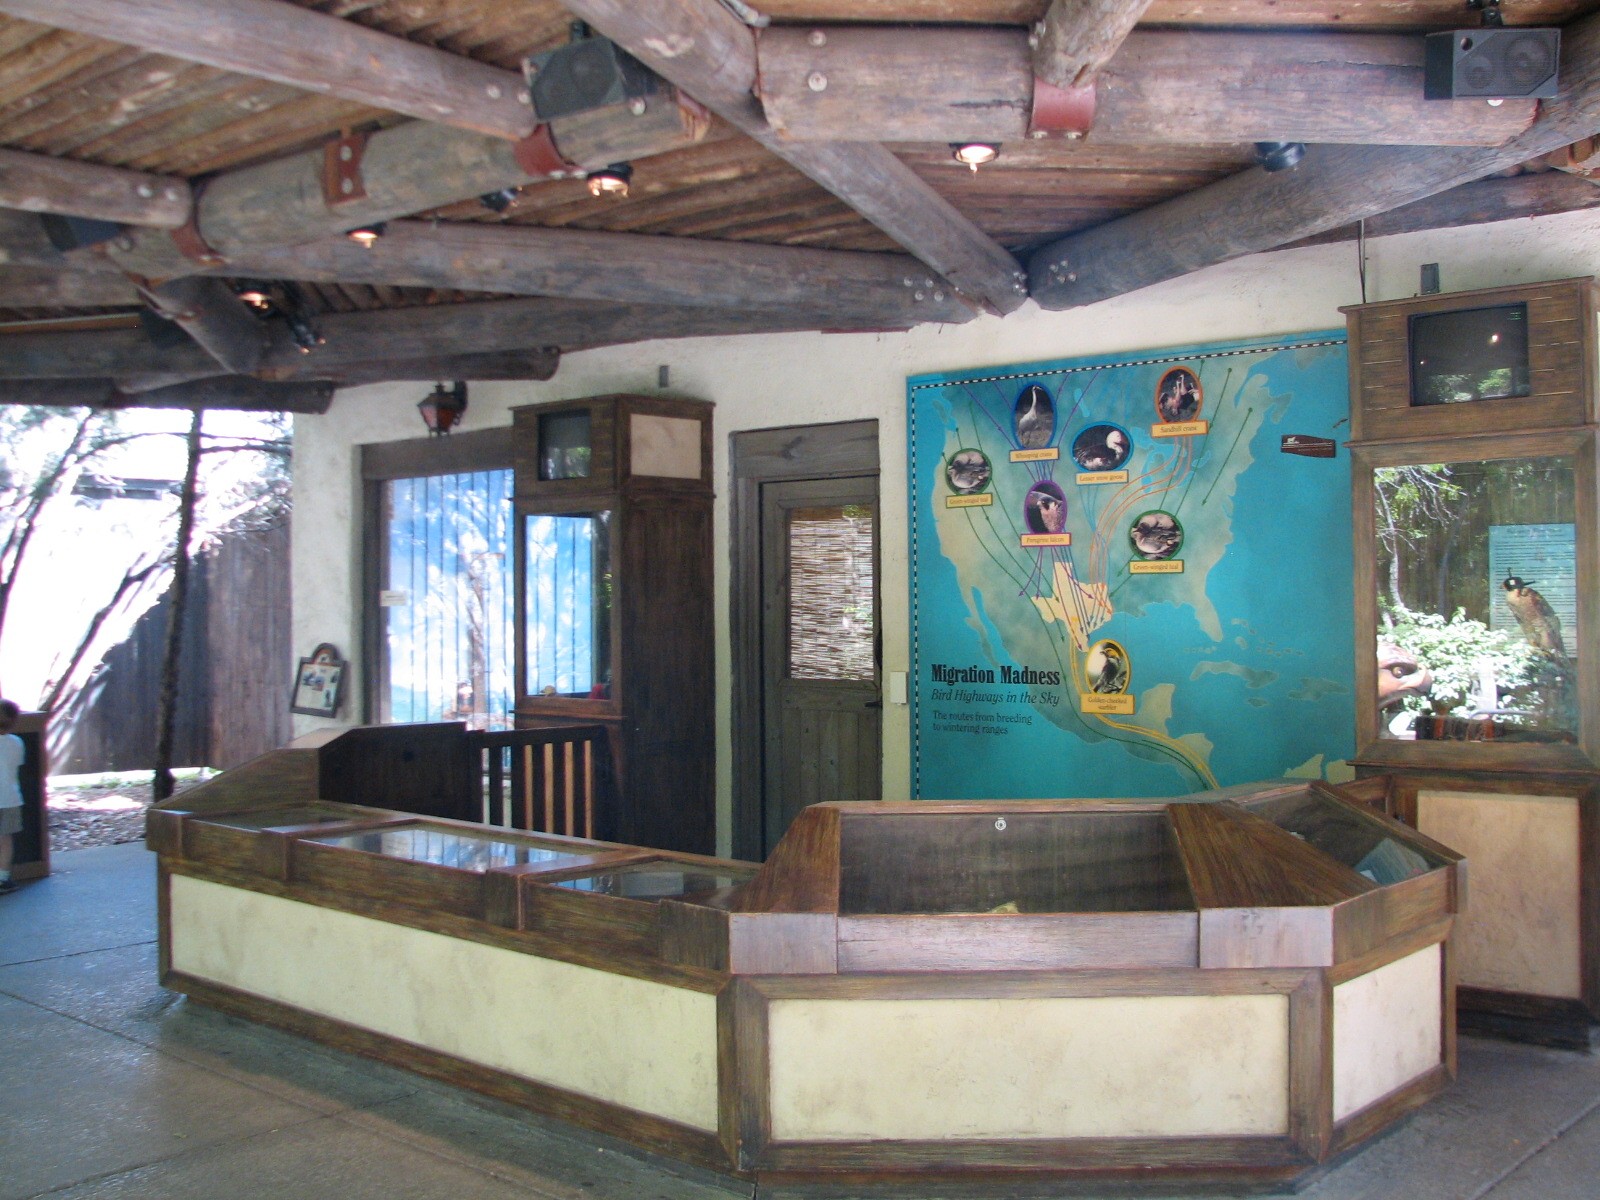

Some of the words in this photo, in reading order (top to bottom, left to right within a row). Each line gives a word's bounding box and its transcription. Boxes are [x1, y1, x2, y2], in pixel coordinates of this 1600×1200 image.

[1161, 425, 1182, 433] Sandhill
[931, 664, 995, 685] Migration
[1001, 665, 1060, 685] Madness
[931, 689, 952, 701] Bird
[955, 689, 1003, 704] Highways
[1007, 690, 1016, 703] in
[1020, 691, 1036, 703] the
[1040, 692, 1060, 707] Sky
[933, 711, 948, 721] The
[949, 712, 974, 722] routes
[974, 712, 995, 722] from
[996, 712, 1032, 724] breeding
[933, 723, 943, 732] to
[944, 723, 981, 735] wintering
[982, 725, 1008, 735] ranges
